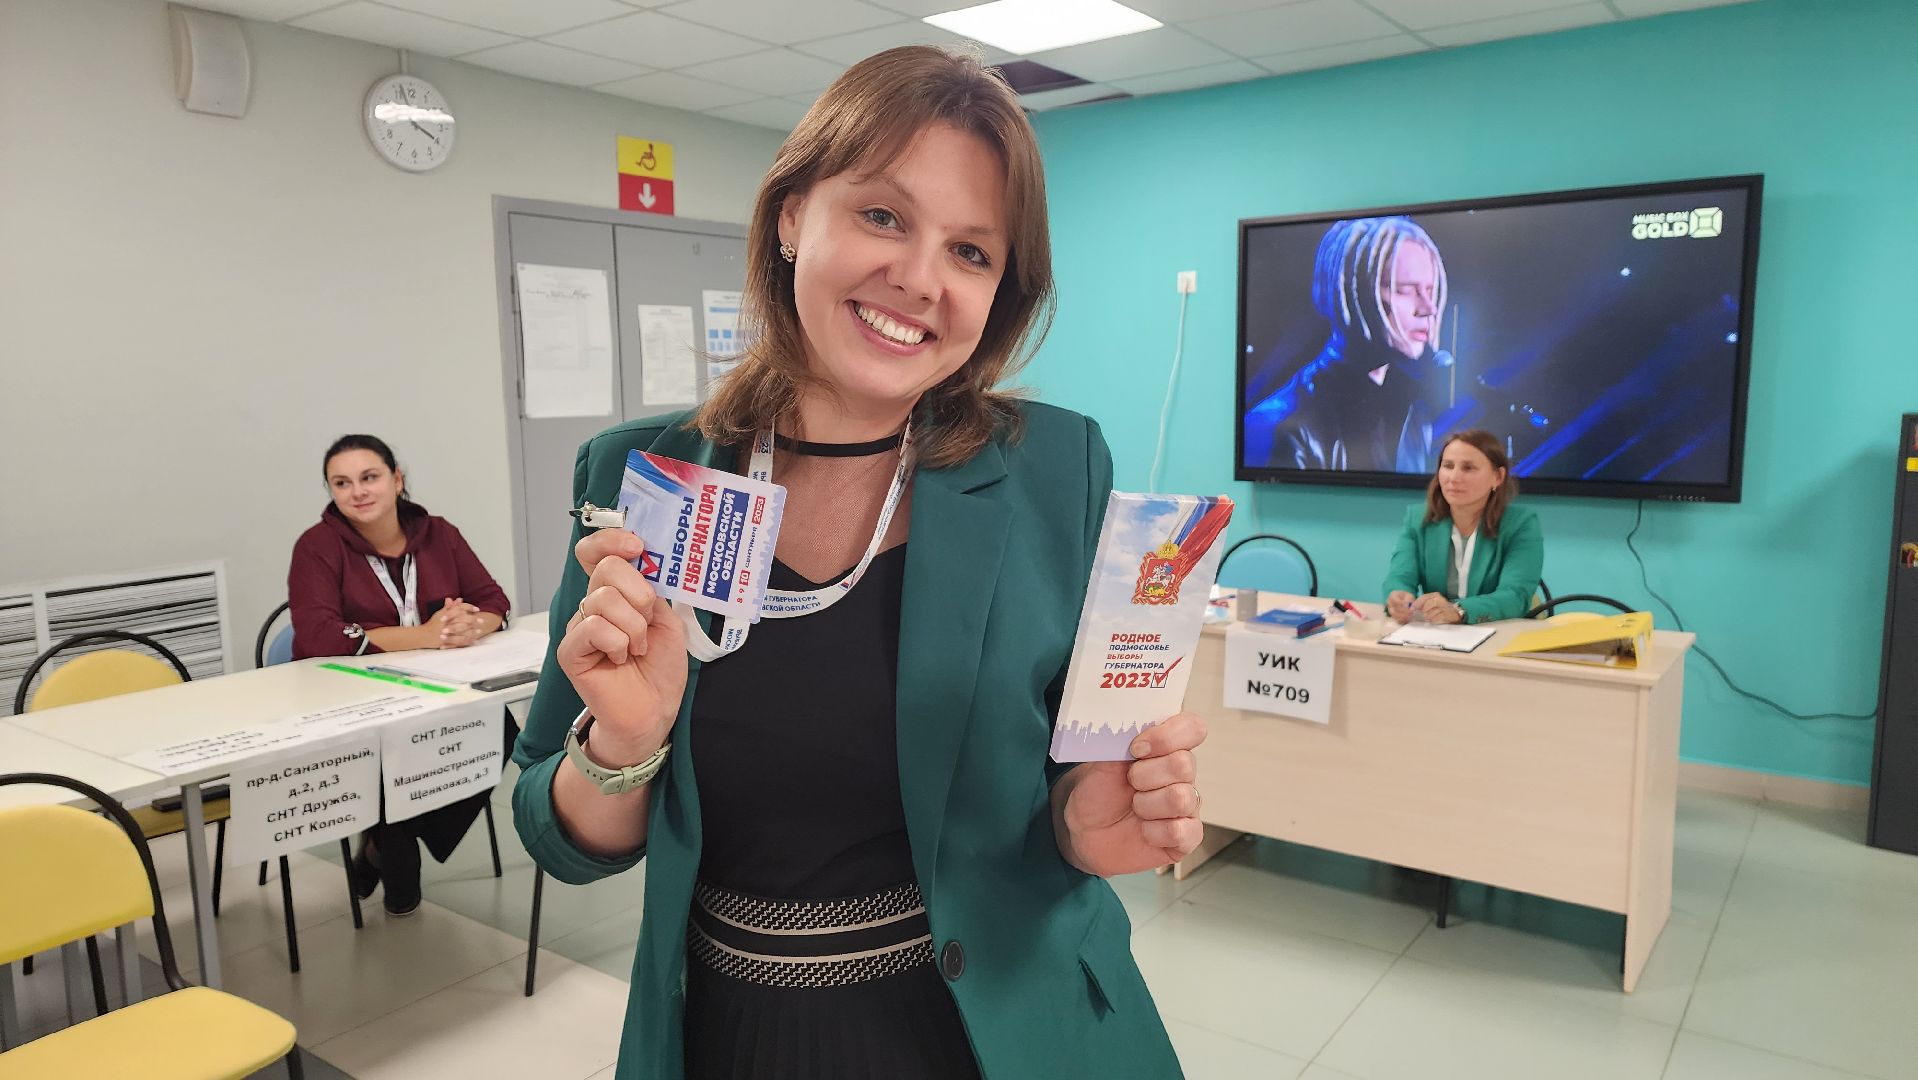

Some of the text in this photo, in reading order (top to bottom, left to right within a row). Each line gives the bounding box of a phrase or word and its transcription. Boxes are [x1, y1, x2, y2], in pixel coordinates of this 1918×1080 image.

[1632, 221, 1690, 240] GOLD
[666, 496, 695, 588] ВЫБОРЫ
[682, 484, 718, 594] ГУБЕРНАТОРА
[707, 492, 736, 594] МОСКОВСКОЙ
[721, 511, 744, 581] ОБЛАСТИ
[740, 571, 750, 586] 10
[753, 498, 764, 524] 2023
[1109, 644, 1170, 652] ПОДМОСКОВЬЕ
[1111, 633, 1162, 644] РОДНОЕ
[1104, 662, 1165, 670] ГУБЕРНАТОРА
[1258, 651, 1301, 673] УИК
[1100, 672, 1152, 689] 2023
[1247, 679, 1310, 704] №709
[411, 719, 487, 744] СНТ Лесное,
[438, 742, 462, 756] СНТ
[394, 750, 500, 788] Машиностроитель,
[288, 774, 340, 799] д.2, д.3
[267, 792, 361, 823] СНТ Дружба,
[274, 814, 356, 842] СНТ Колос,
